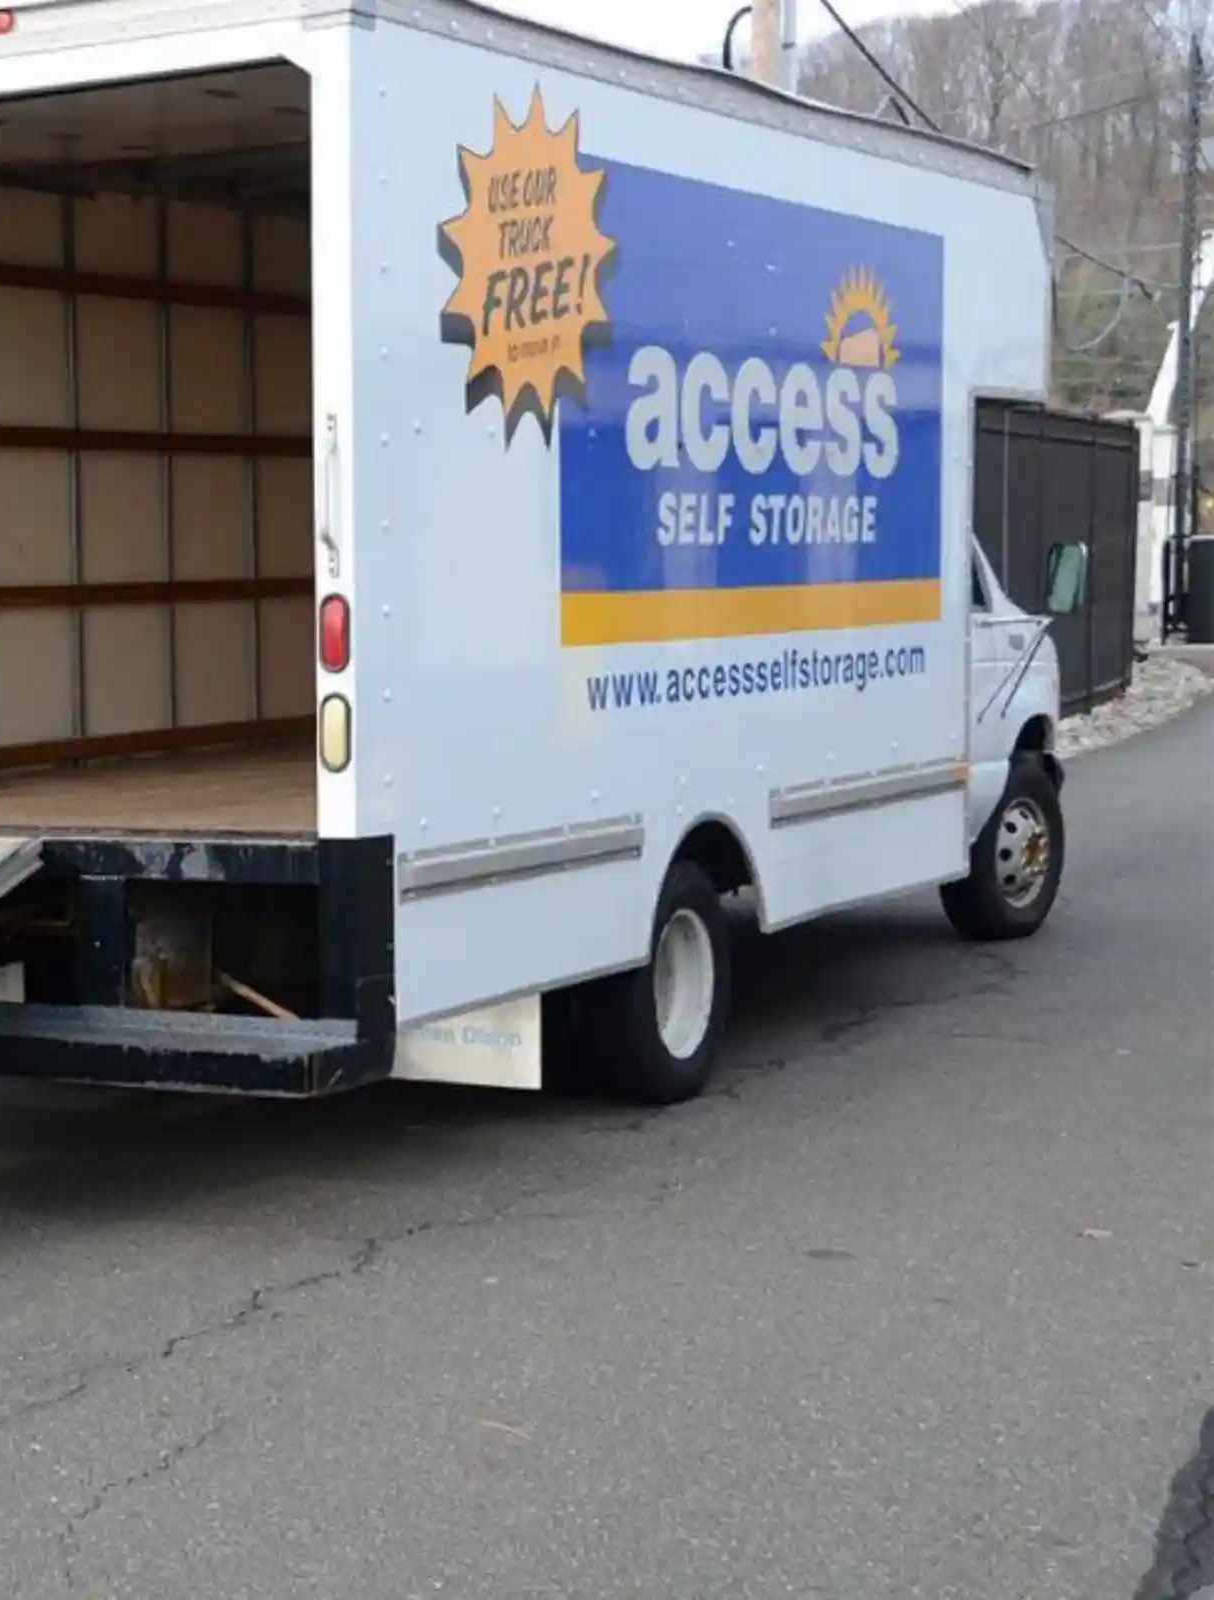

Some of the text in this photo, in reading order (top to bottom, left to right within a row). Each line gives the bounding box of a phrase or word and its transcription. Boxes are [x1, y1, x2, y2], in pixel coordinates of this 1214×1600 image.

[488, 166, 557, 213] USE OUR
[499, 215, 555, 260] TRUCK
[482, 253, 590, 337] FREE!
[626, 345, 899, 479] access
[656, 491, 878, 546] SELF STORAGE
[586, 645, 927, 711] www.accessselfstorage.com
